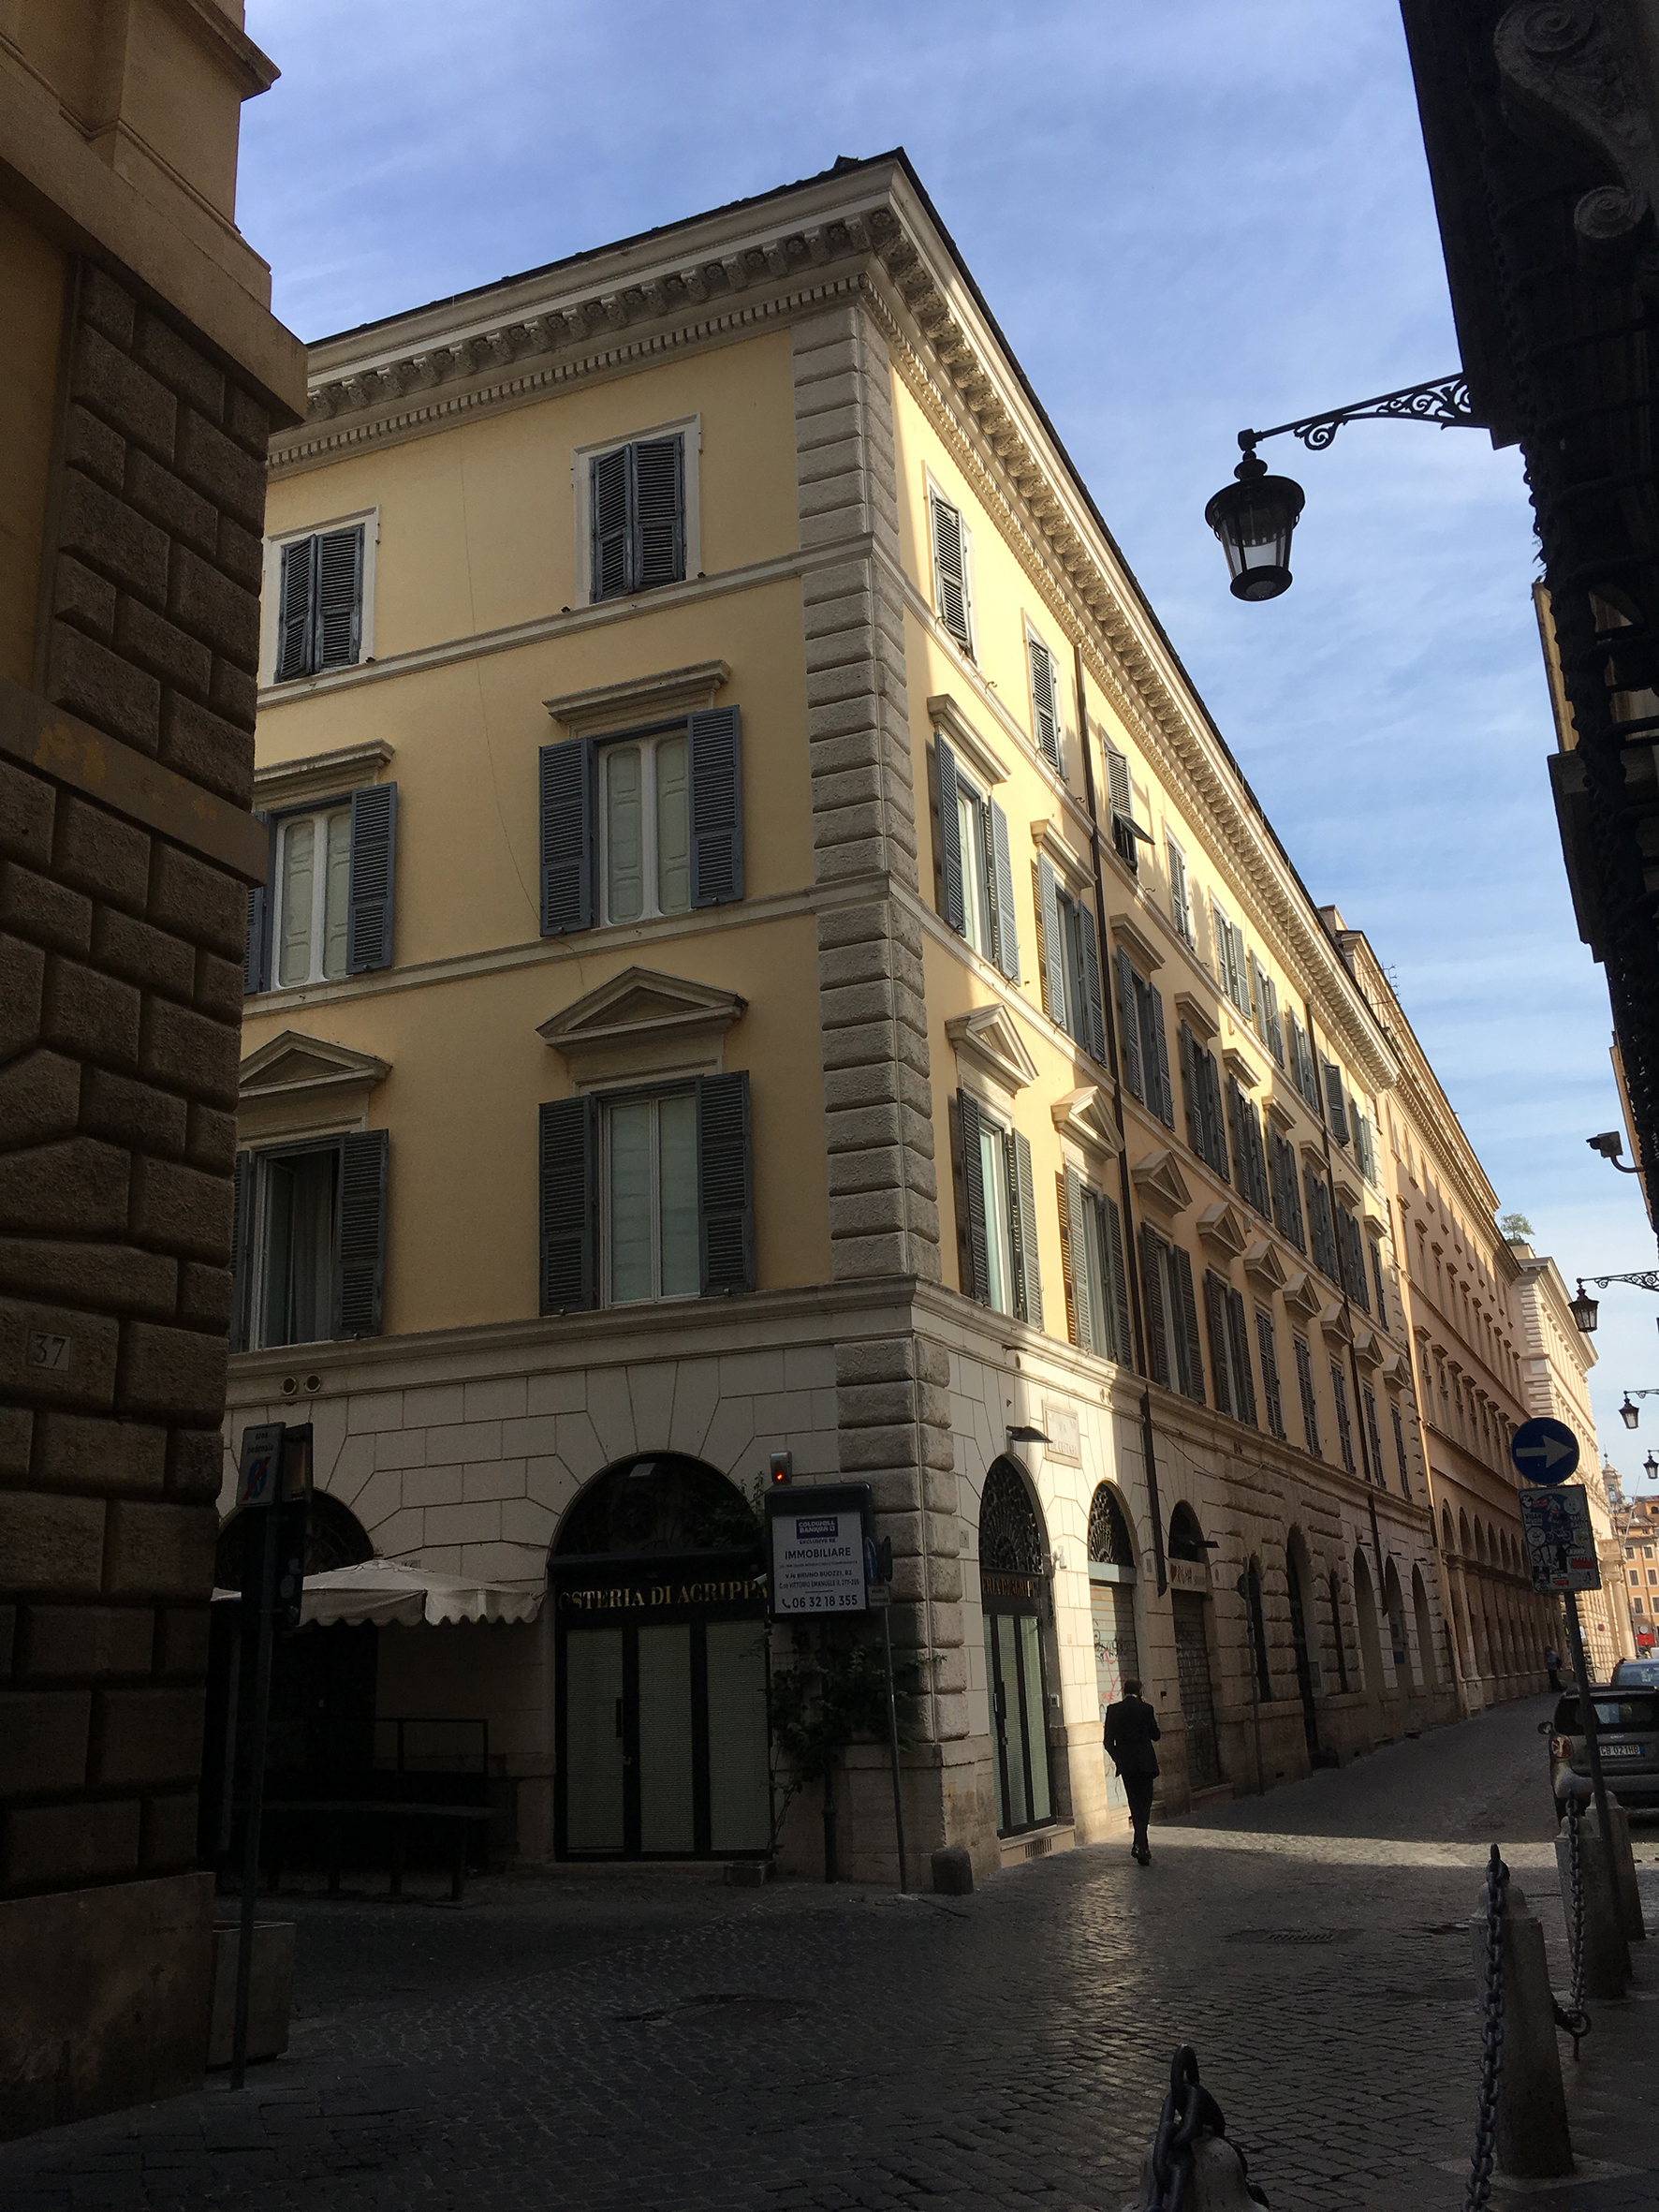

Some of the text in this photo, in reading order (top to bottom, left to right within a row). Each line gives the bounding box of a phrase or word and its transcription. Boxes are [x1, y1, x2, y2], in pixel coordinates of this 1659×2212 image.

[34, 1335, 66, 1367] 37
[785, 1547, 851, 1559] IMMOBILIARE
[811, 1579, 836, 1587] EMANUELE
[558, 1580, 768, 1610] OSTERIA DI AGRIPPA
[792, 1595, 858, 1608] 06 32 18 355
